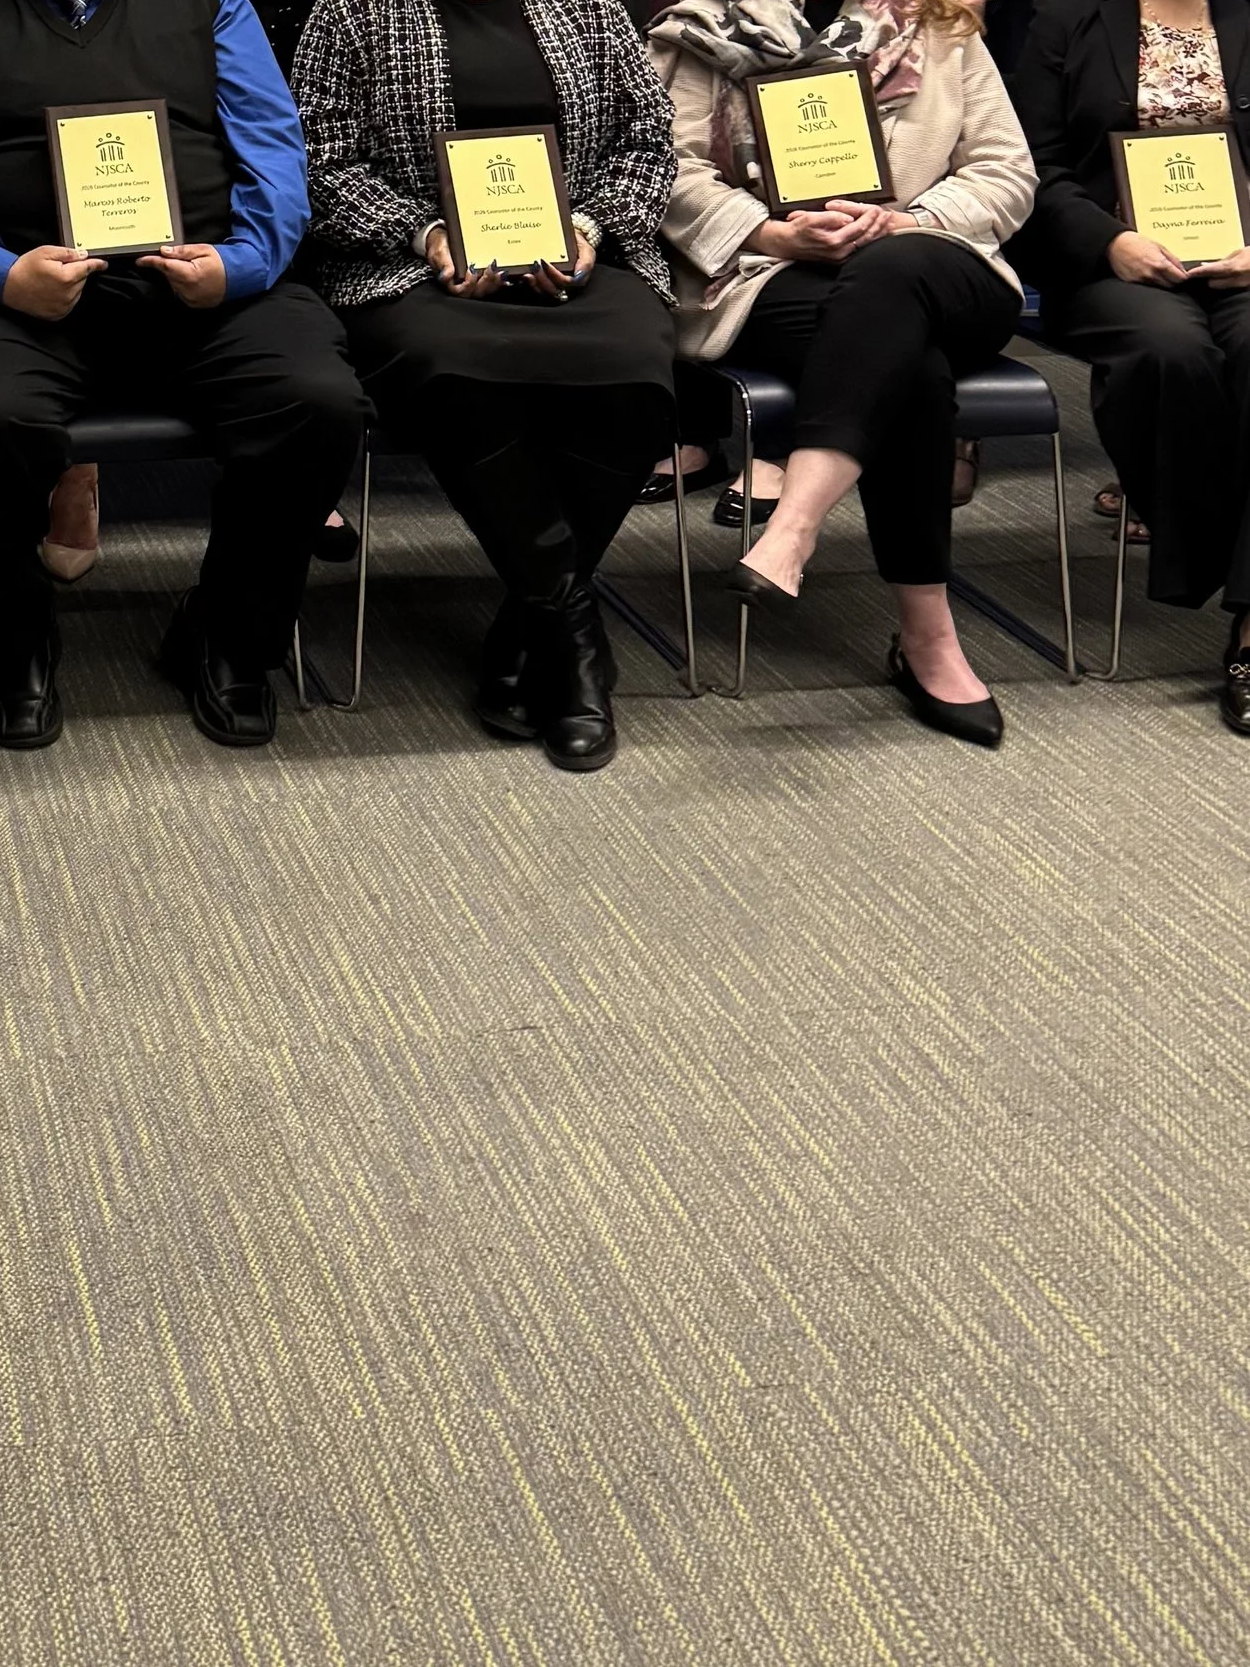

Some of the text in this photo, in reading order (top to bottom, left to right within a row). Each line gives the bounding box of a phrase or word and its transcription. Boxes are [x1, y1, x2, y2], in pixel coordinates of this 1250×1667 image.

[797, 119, 838, 134] NJSCA
[95, 162, 134, 177] NJSCA
[486, 184, 525, 197] NJSCA
[1164, 182, 1205, 194] NJSCA
